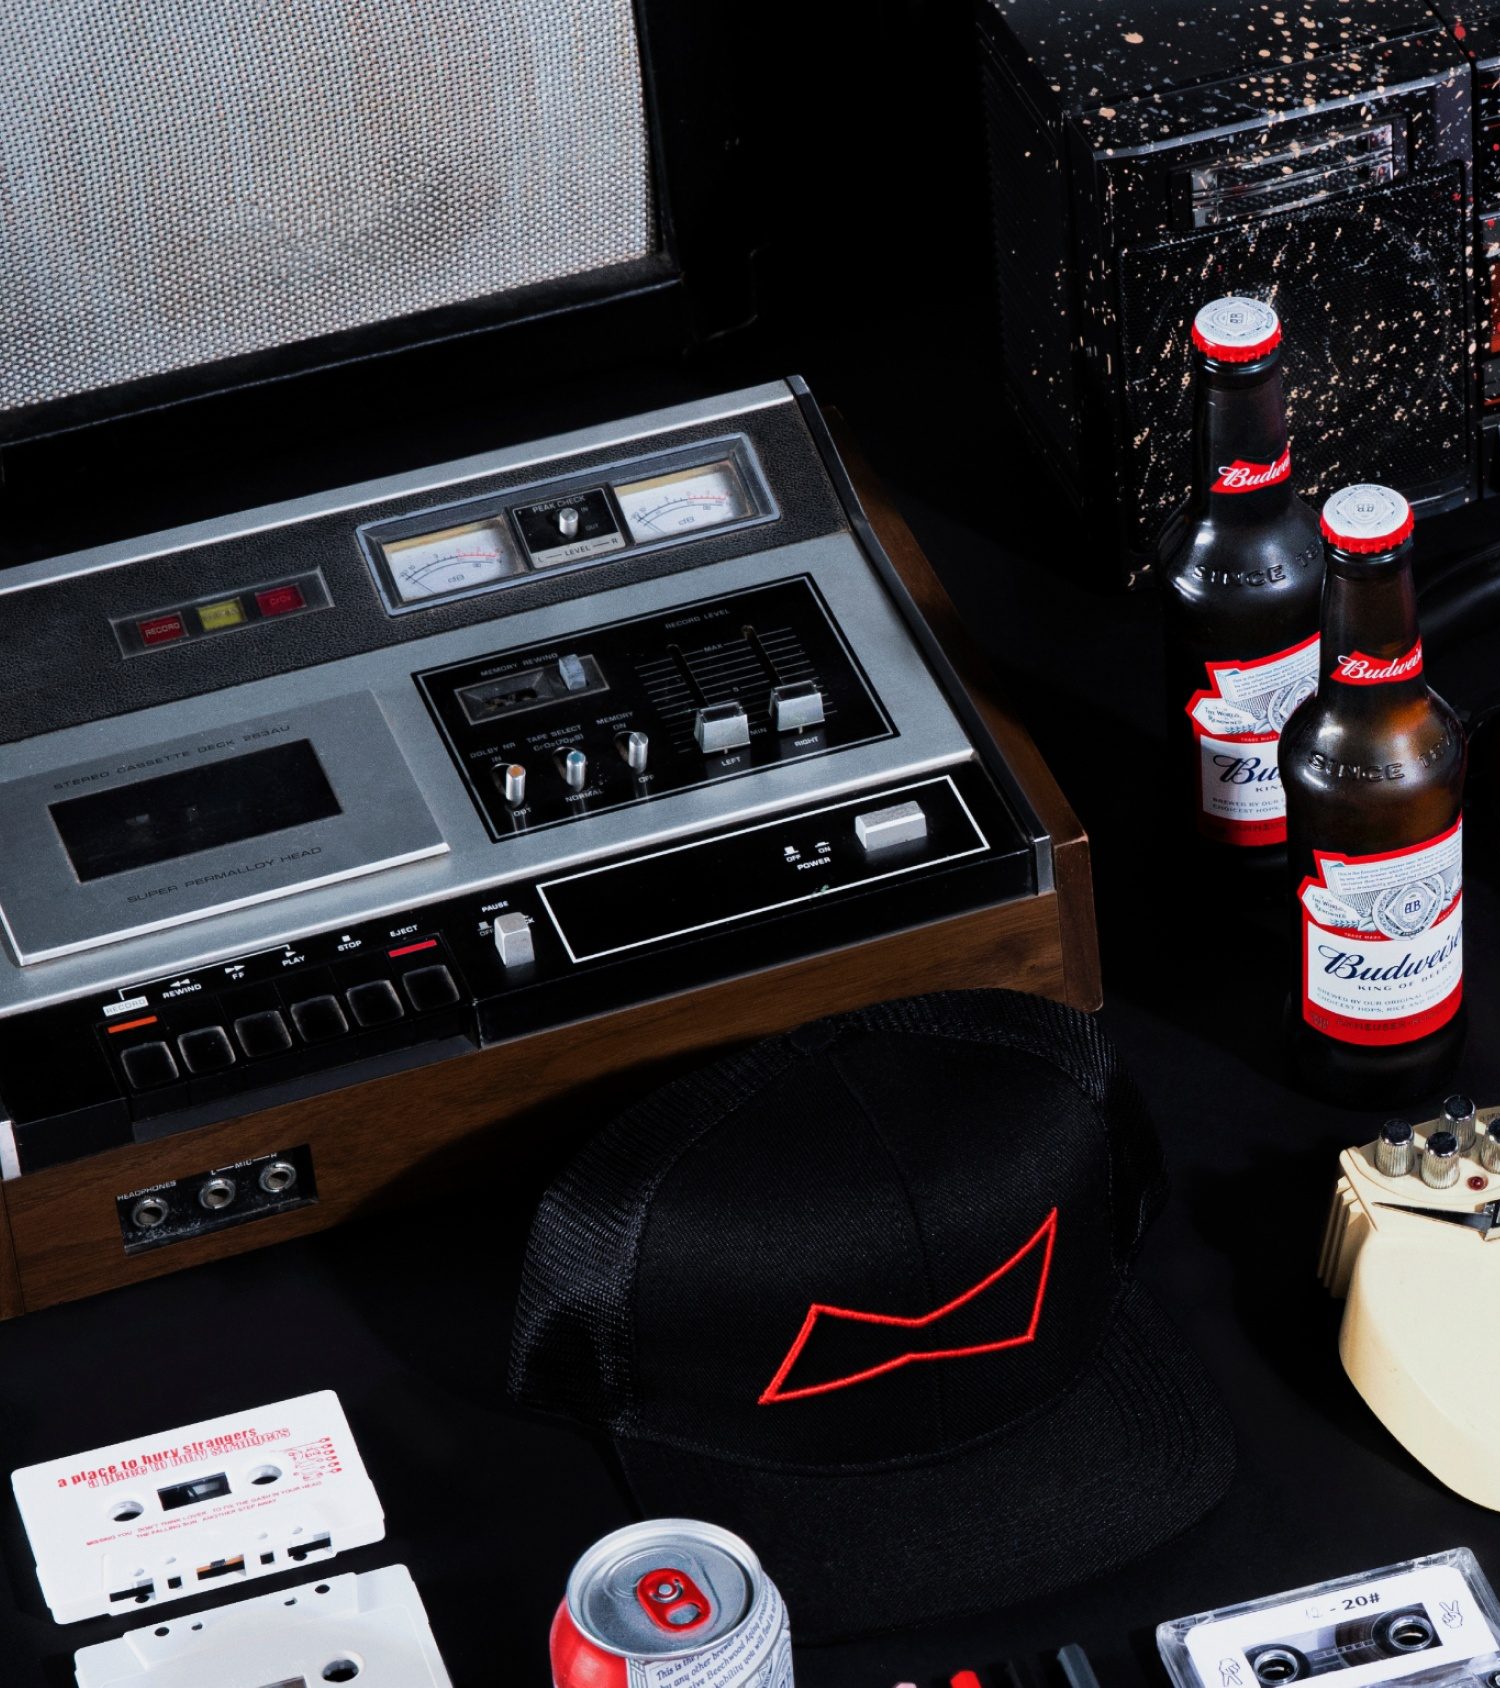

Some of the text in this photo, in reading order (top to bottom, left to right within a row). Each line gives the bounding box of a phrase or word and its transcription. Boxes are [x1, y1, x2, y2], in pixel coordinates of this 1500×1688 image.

[532, 501, 555, 513] PEAK
[565, 544, 591, 556] LEVEL
[1192, 565, 1286, 586] SINCE
[665, 609, 730, 629] RECORD LEVEL
[146, 623, 180, 637] RECORD
[481, 653, 558, 677] MEMORY REWIND
[596, 712, 633, 725] MEMORY
[526, 725, 582, 743] TAPE SELECT
[795, 736, 818, 747] RIGHT
[54, 771, 110, 790] STEREO
[117, 751, 190, 774] CASSETTE
[197, 739, 235, 754] DECK
[721, 757, 741, 766] LEFT
[1307, 751, 1405, 782] SINCE
[565, 788, 603, 803] NORMAL
[797, 856, 831, 871] POWER
[127, 847, 322, 903] SUPER PERMALLOY HEAD
[482, 901, 509, 912] PAUSE
[1405, 900, 1421, 914] AB
[389, 924, 418, 937] EJECT
[337, 939, 362, 951] STOP
[282, 955, 305, 967] PLAY
[1318, 929, 1462, 981] Budweise
[162, 983, 202, 999] REWIND
[1399, 981, 1413, 989] OF
[117, 1180, 177, 1200] HEADPHONES
[57, 1428, 257, 1488] a place to bury strangers
[1342, 1593, 1380, 1610] 20#
[707, 1639, 746, 1679] Beechwood
[656, 1668, 673, 1680] This
[674, 1658, 711, 1687] any other
